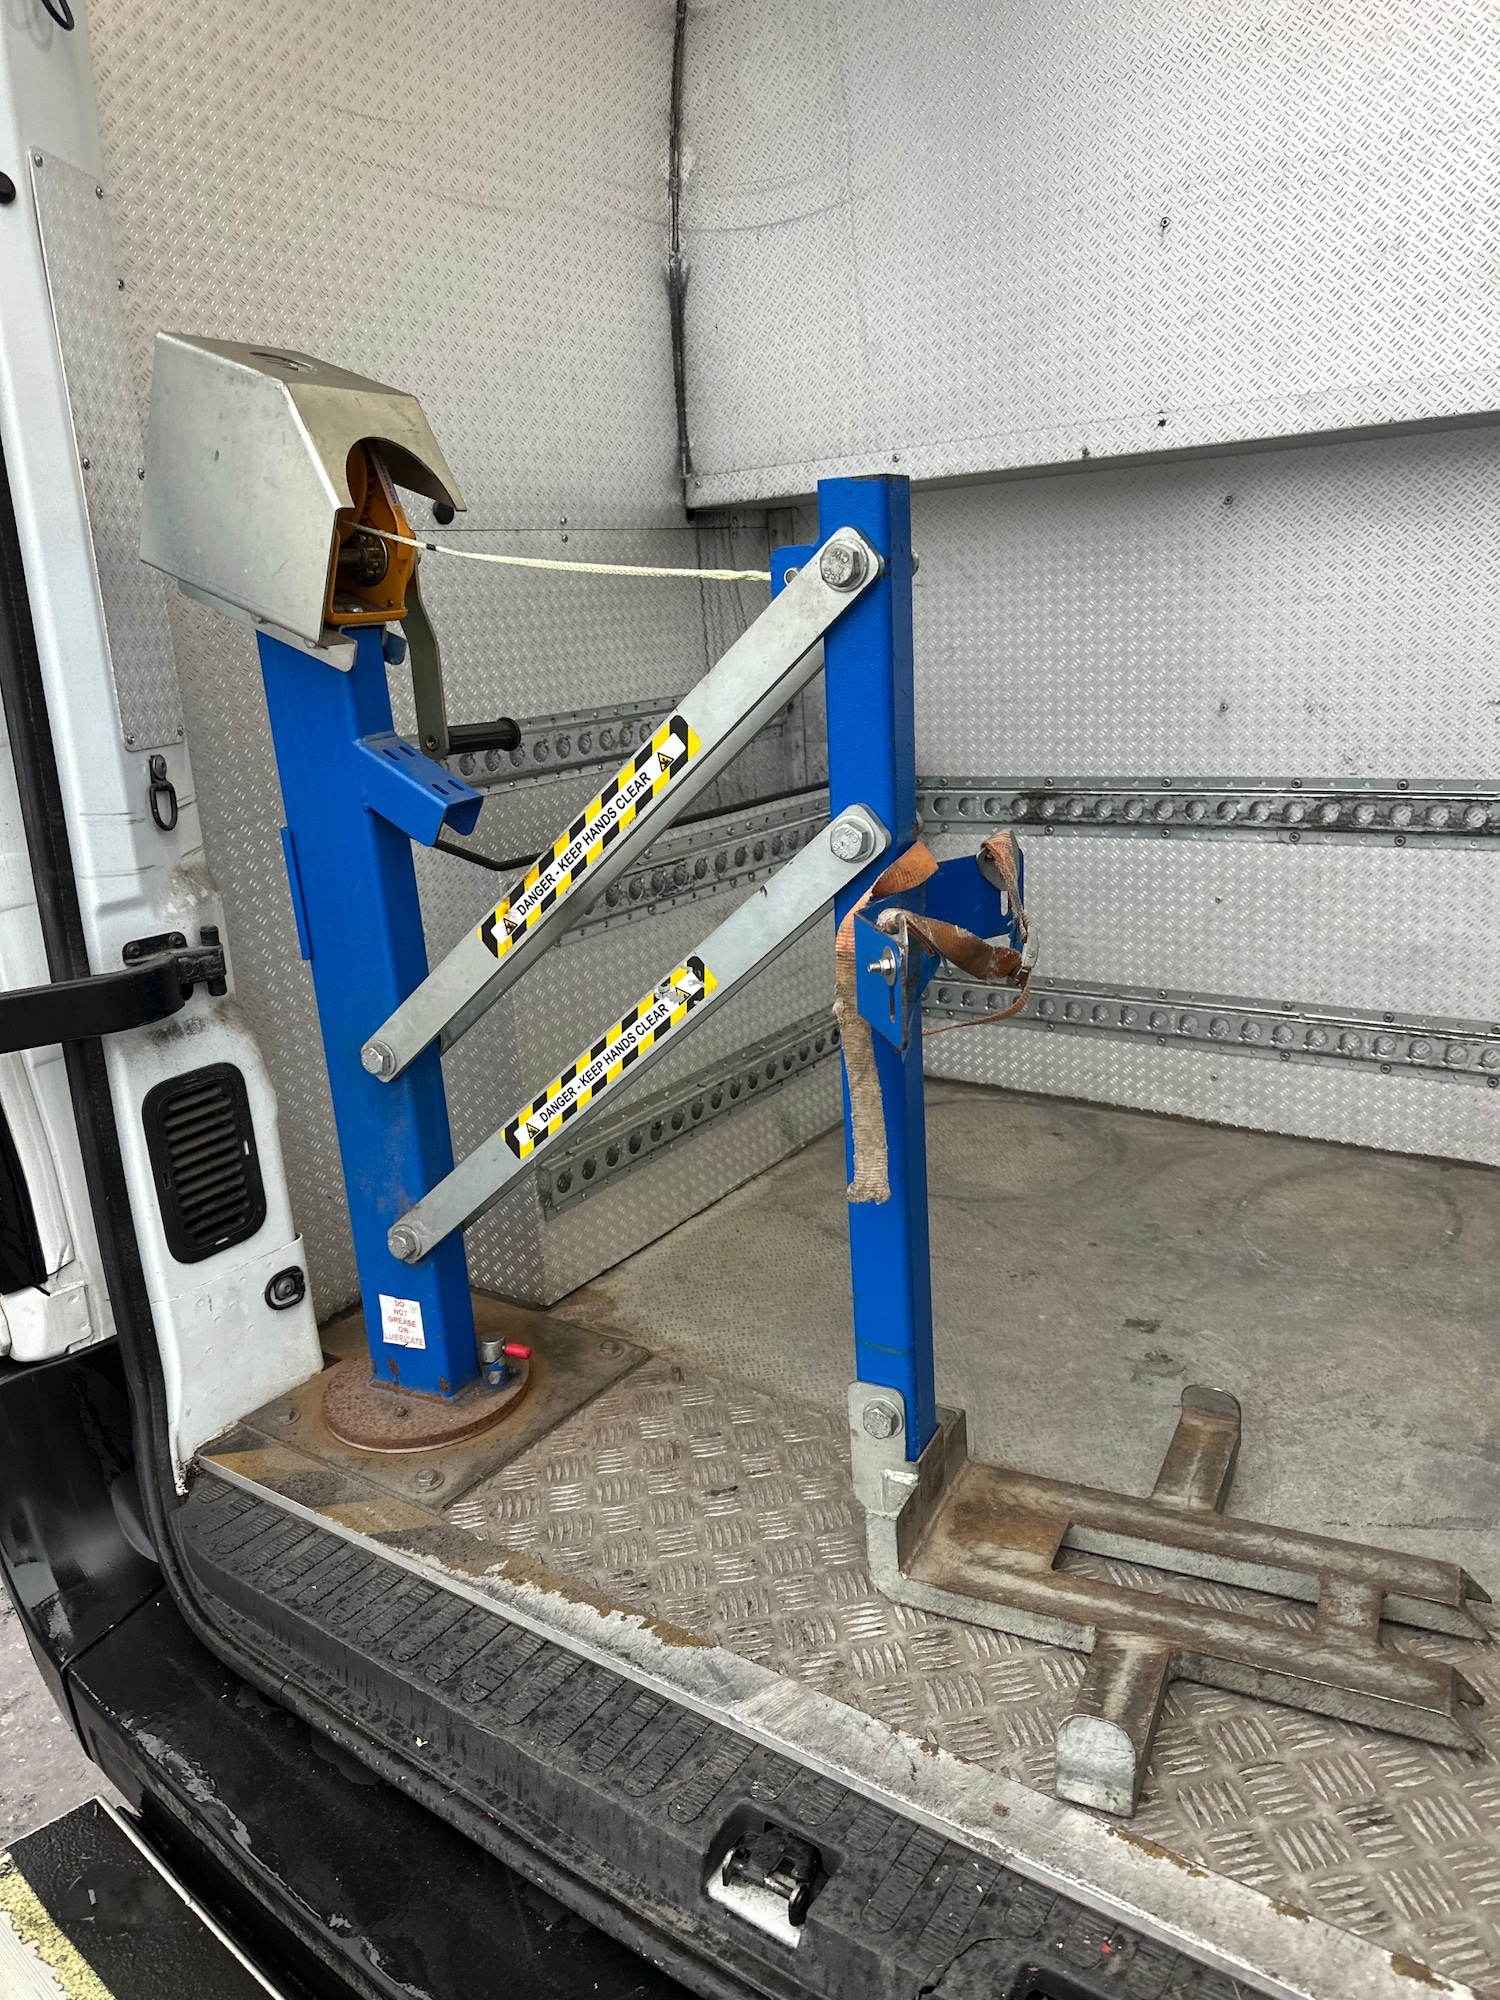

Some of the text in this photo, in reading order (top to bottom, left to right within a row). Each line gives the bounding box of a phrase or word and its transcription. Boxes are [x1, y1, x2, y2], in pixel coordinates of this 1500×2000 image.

[517, 873, 556, 915] DANGER
[558, 842, 583, 872] KEEP
[582, 807, 617, 845] HANDS
[616, 771, 652, 810] CLEAR
[539, 1085, 578, 1123] DANGER
[579, 1061, 603, 1087] KEEP
[602, 1033, 637, 1066] HANDS
[635, 1003, 670, 1036] CLEAR
[394, 1300, 405, 1308] DO
[393, 1308, 408, 1317] NOT
[388, 1316, 417, 1328] GREASE
[398, 1326, 409, 1334] OR
[384, 1332, 424, 1346] LUBRICATE
